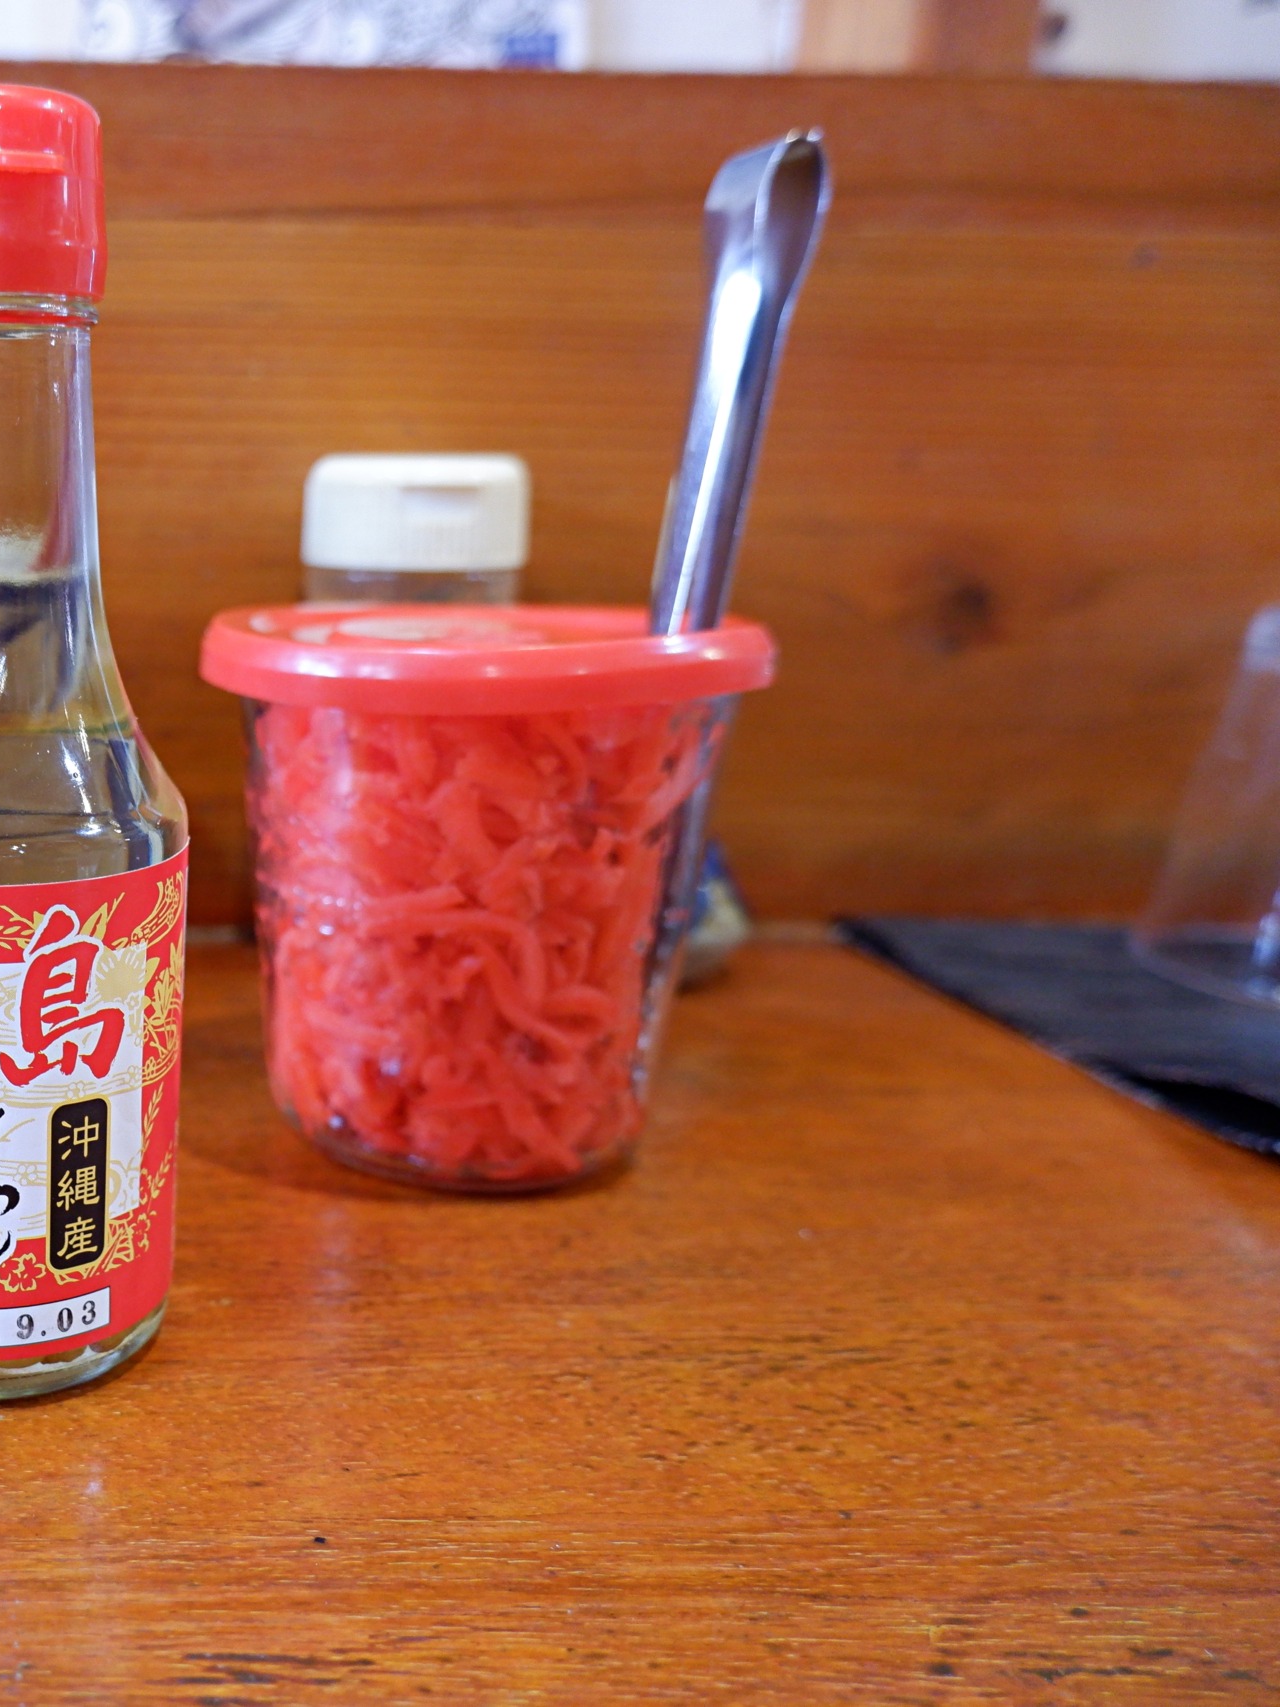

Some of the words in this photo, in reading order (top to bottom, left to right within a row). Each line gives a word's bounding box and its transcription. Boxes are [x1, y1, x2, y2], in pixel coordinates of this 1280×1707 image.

[0, 911, 124, 1087] 島
[56, 1115, 100, 1259] 沖縄産
